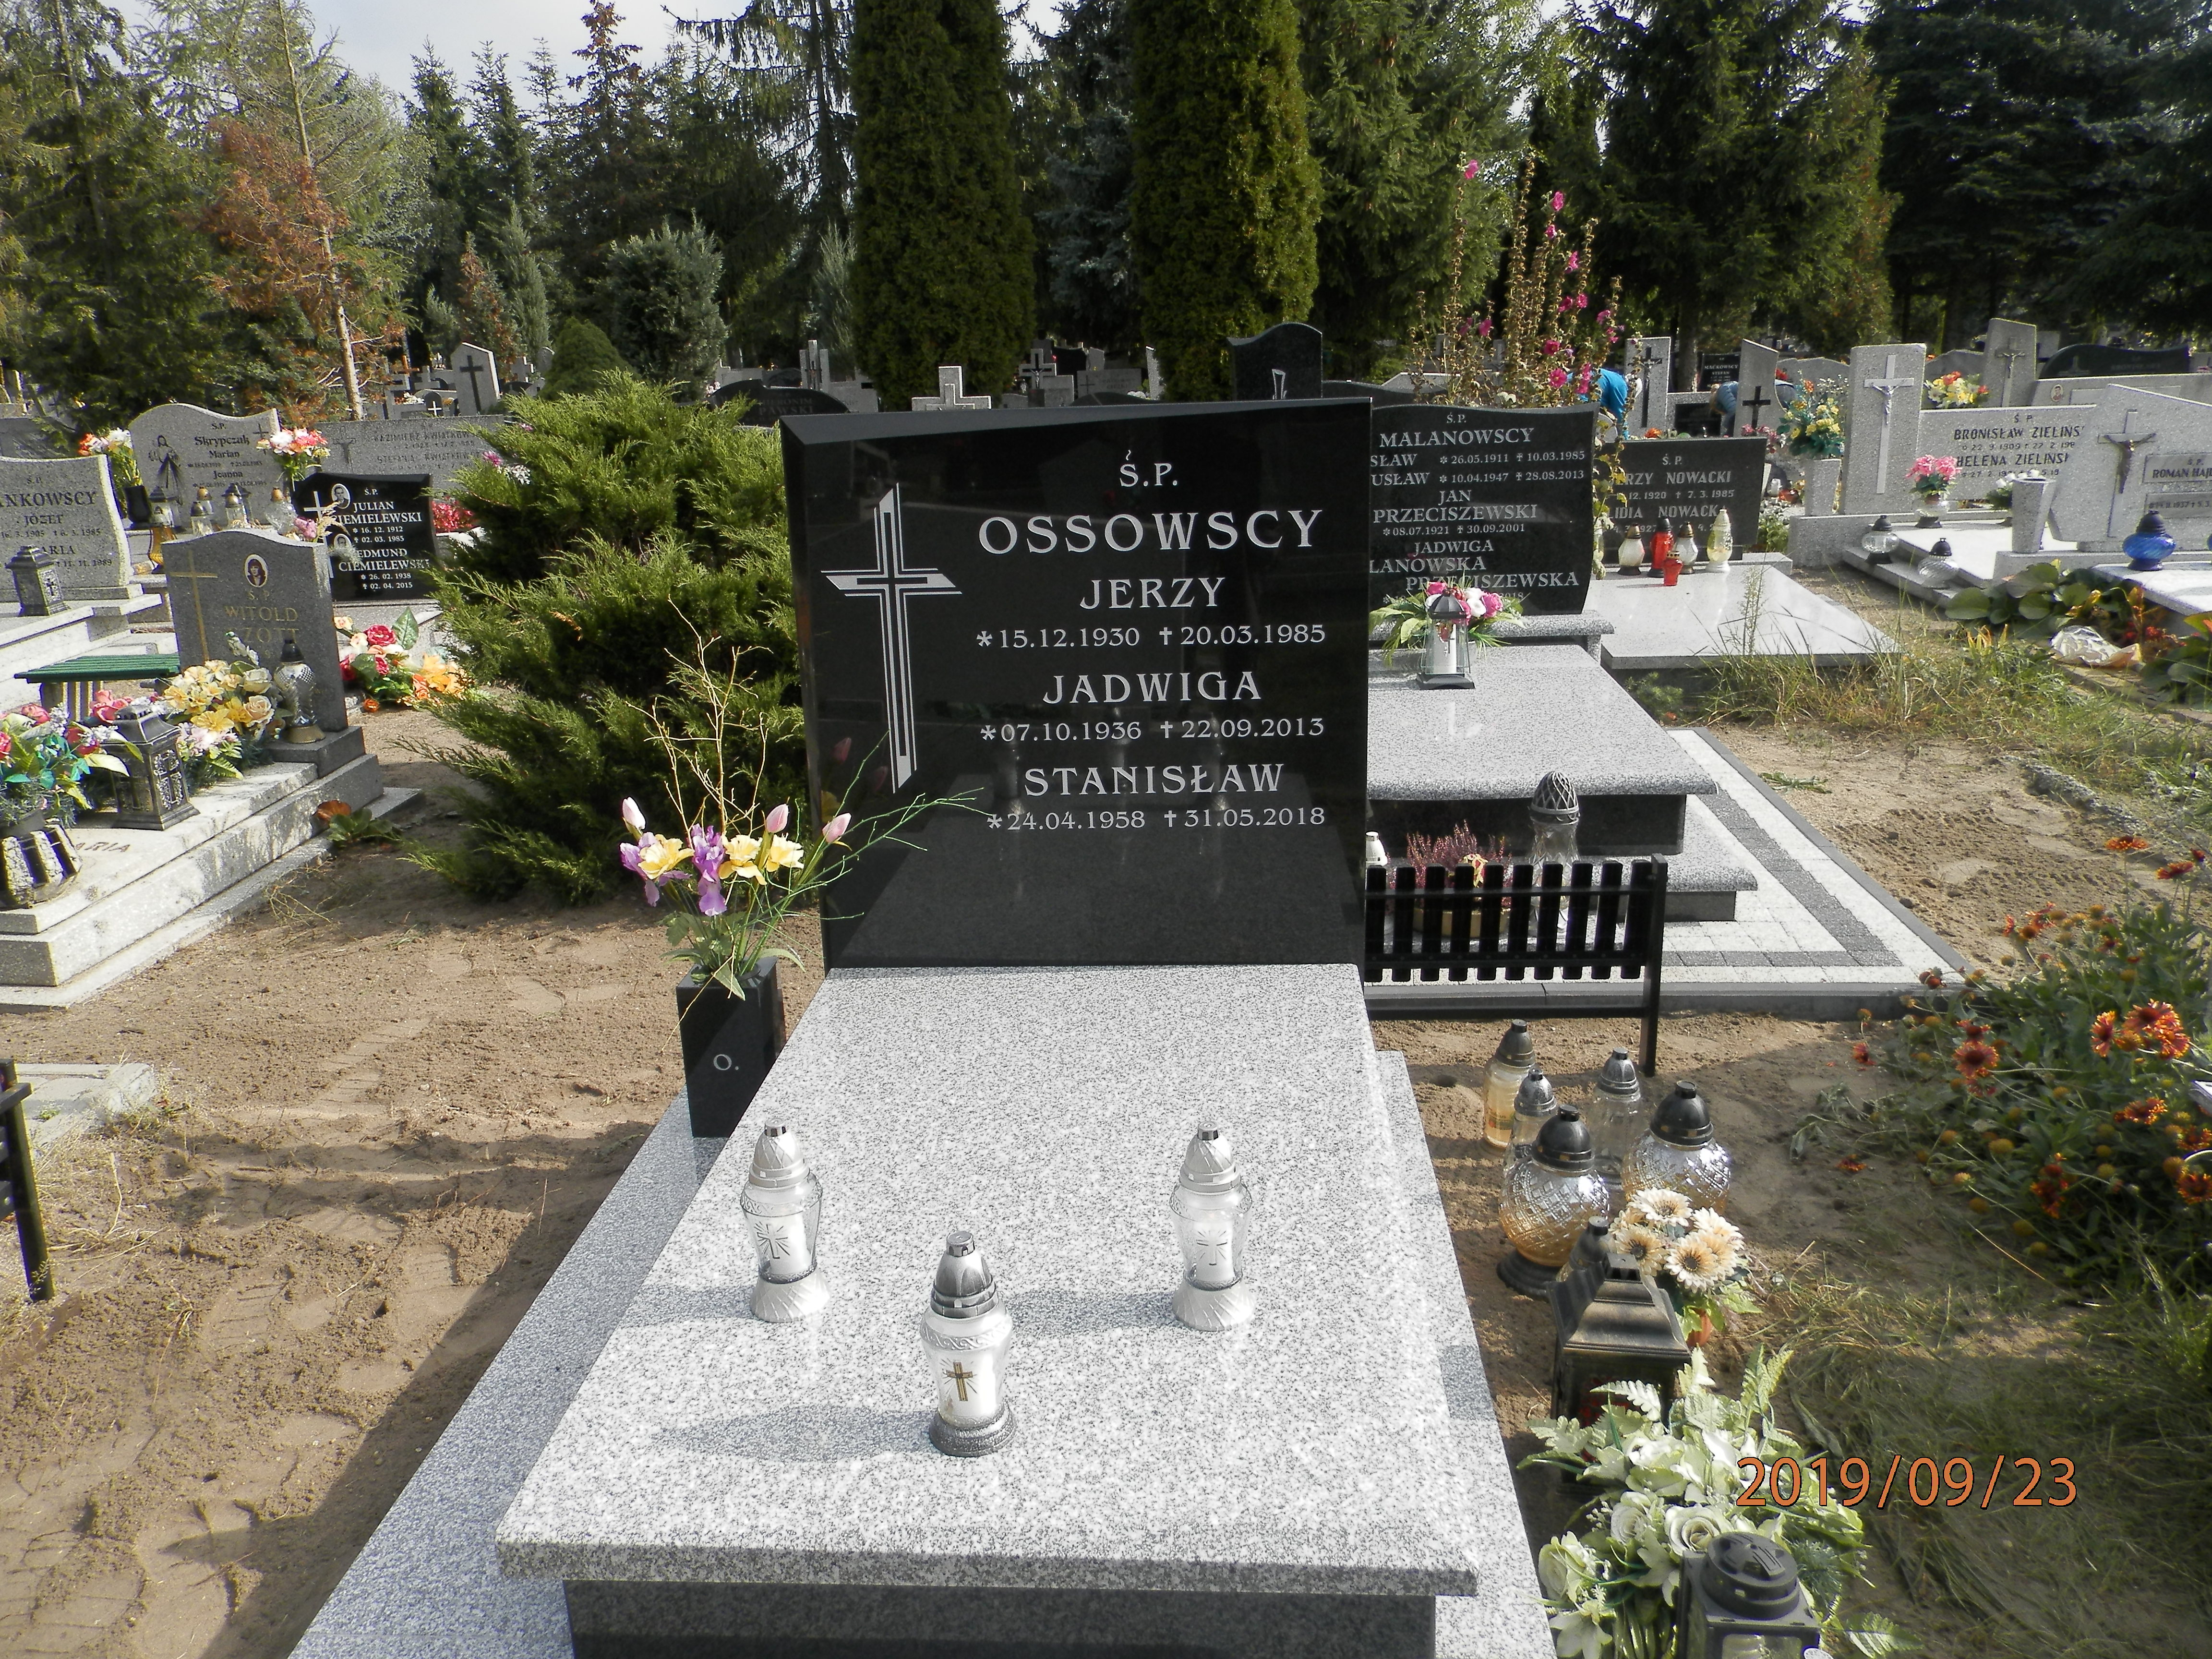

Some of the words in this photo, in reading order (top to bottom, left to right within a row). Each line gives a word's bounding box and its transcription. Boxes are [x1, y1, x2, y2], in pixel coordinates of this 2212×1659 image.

[1446, 412, 1467, 423] Ś.P.
[1379, 428, 1534, 447] MALANOWSCY
[1954, 428, 2024, 440] BRONISŁAW
[2032, 425, 2084, 438] ZIELINS
[194, 434, 250, 447] Skrypczuk
[1451, 454, 1509, 464] 26.05.1911
[1527, 451, 1585, 461] 10.03.1985
[1957, 455, 2006, 467] HELENA
[1120, 450, 1178, 487] Ś.P.
[2152, 468, 2189, 478] ROMAN
[1452, 473, 1509, 483] 10.04.1947
[1526, 470, 1584, 481] 28.08.2013
[1616, 472, 1654, 485] RZY
[1667, 470, 1731, 484] NOWACKI
[1438, 490, 1472, 506] JAN
[1644, 491, 1667, 499] 1920
[1712, 489, 1735, 497] 1985
[353, 501, 395, 513] JULIAN
[1373, 504, 1538, 524] PRZECISZEWSKI
[1658, 505, 1727, 517] NOWACK
[979, 510, 1322, 554] OSSOWSCY
[1393, 526, 1449, 536] 08.07.1921
[1467, 523, 1525, 534] 30.09.2001
[1640, 525, 1657, 533] 927
[41, 545, 76, 555] ARIA
[357, 548, 408, 558] EDMUND
[1414, 540, 1494, 557] JADWIGA
[338, 559, 430, 571] CIEMIELEWSKI
[1080, 577, 1225, 609] JERZY
[224, 605, 298, 621] WITOLD
[227, 626, 300, 644] ZOTT
[1000, 627, 1140, 648] 15.12.1930
[1180, 624, 1325, 645] 20.03.1985
[1043, 671, 1262, 704] JADWIGA
[1001, 721, 1142, 742] 07.10.1936
[1181, 718, 1323, 738] 22.09.2013
[1024, 763, 1284, 796] STANISŁAW
[1007, 810, 1145, 830] 24.04.1958
[1184, 807, 1325, 827] 31.05.2018
[75, 842, 131, 853] ARIA
